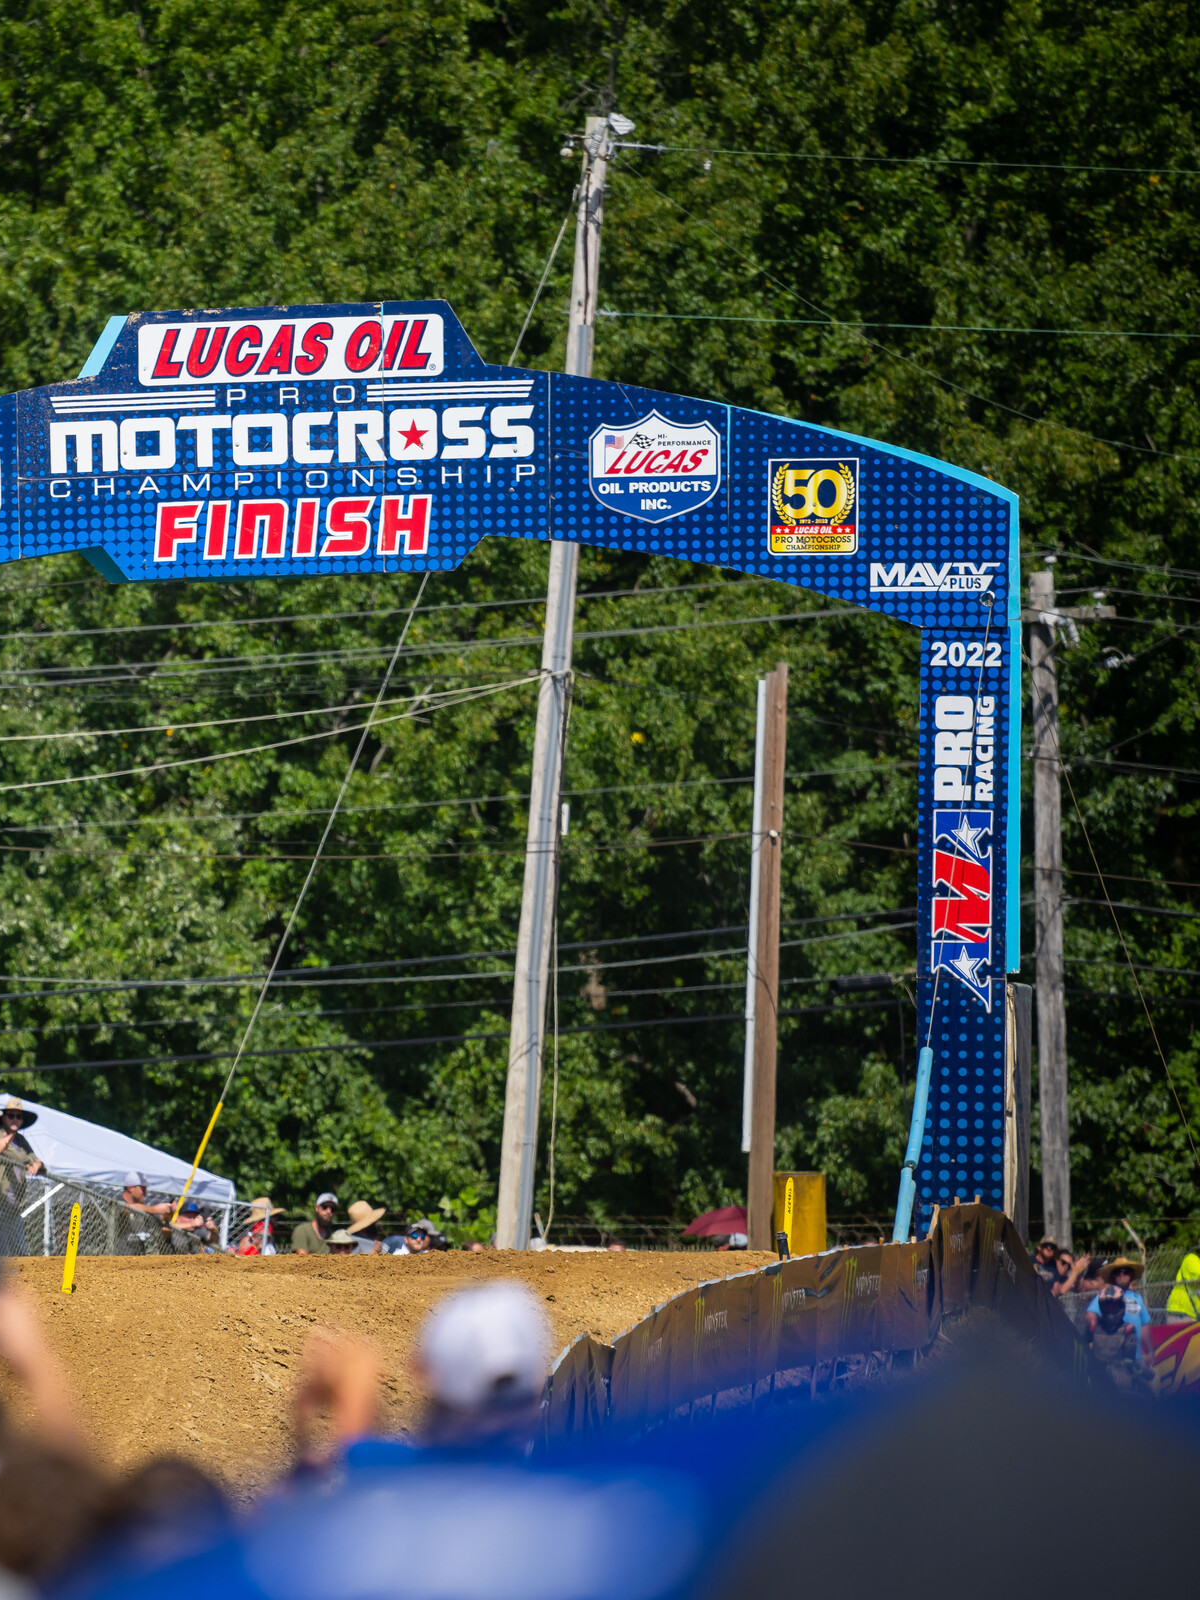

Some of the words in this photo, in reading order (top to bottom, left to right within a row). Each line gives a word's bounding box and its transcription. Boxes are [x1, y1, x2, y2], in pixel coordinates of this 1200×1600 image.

[150, 321, 335, 379] LUCAS
[344, 319, 431, 372] OIL
[226, 385, 356, 406] PRO
[49, 405, 535, 474] MOTOCROSS
[604, 448, 709, 475] LUCAS
[49, 463, 537, 498] CHAMPIONSHIP
[598, 483, 625, 494] OIL
[629, 481, 712, 494] PRODUCTS
[782, 469, 848, 519] 50
[640, 498, 672, 511] INC.
[153, 494, 433, 562] FINISH
[794, 526, 820, 534] LUCAS
[820, 526, 833, 534] OIL
[796, 536, 852, 544] MOTOCROSS
[949, 577, 982, 590] PLUS
[930, 641, 1002, 667] 2022
[934, 695, 974, 801] PRO
[974, 696, 995, 802] RACING
